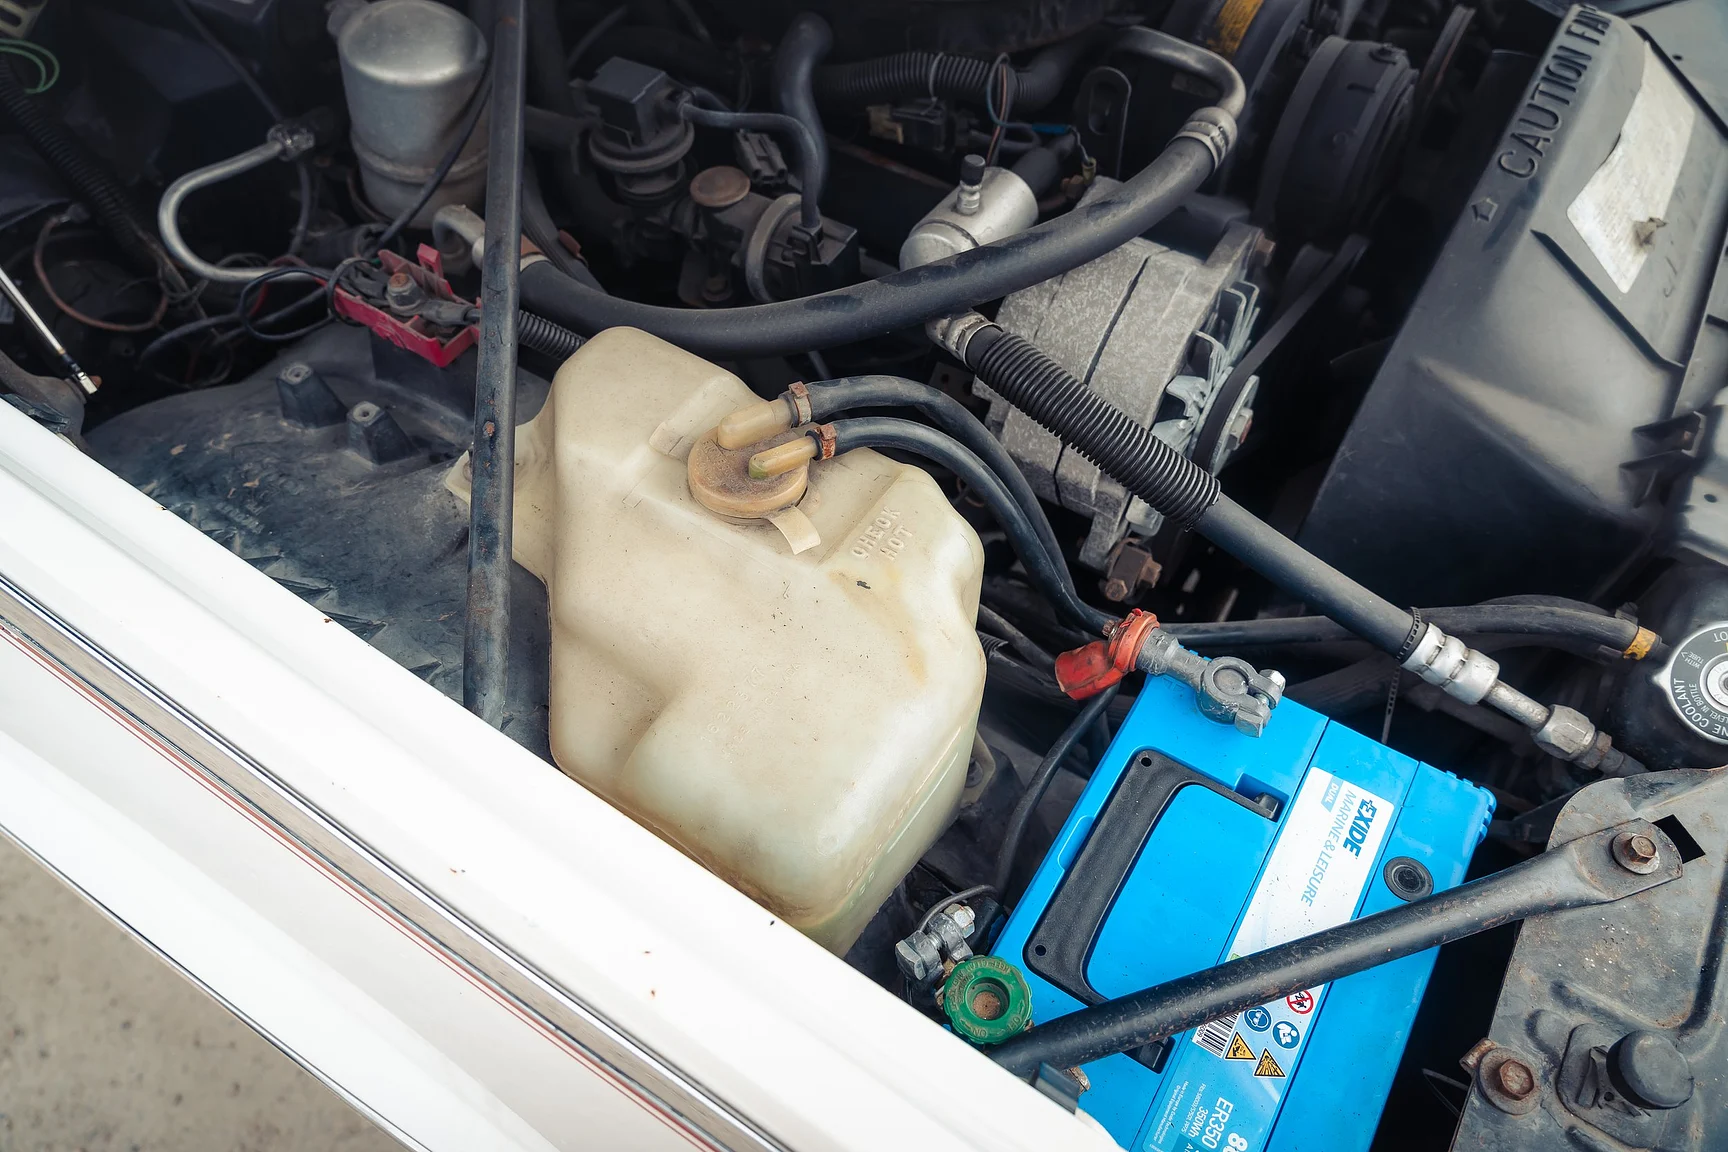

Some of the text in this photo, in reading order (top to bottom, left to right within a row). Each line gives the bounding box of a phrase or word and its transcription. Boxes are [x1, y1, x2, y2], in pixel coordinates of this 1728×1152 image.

[1498, 45, 1592, 178] CAUTION
[1674, 678, 1709, 728] COOLANT
[1689, 683, 1704, 706] BOTTLE
[1325, 782, 1340, 803] DUAL
[1301, 790, 1357, 907] MARINE & LEISURE
[1342, 798, 1377, 857] EXIDE
[1188, 1106, 1208, 1138] 350Wh
[1201, 1097, 1234, 1149] ER350
